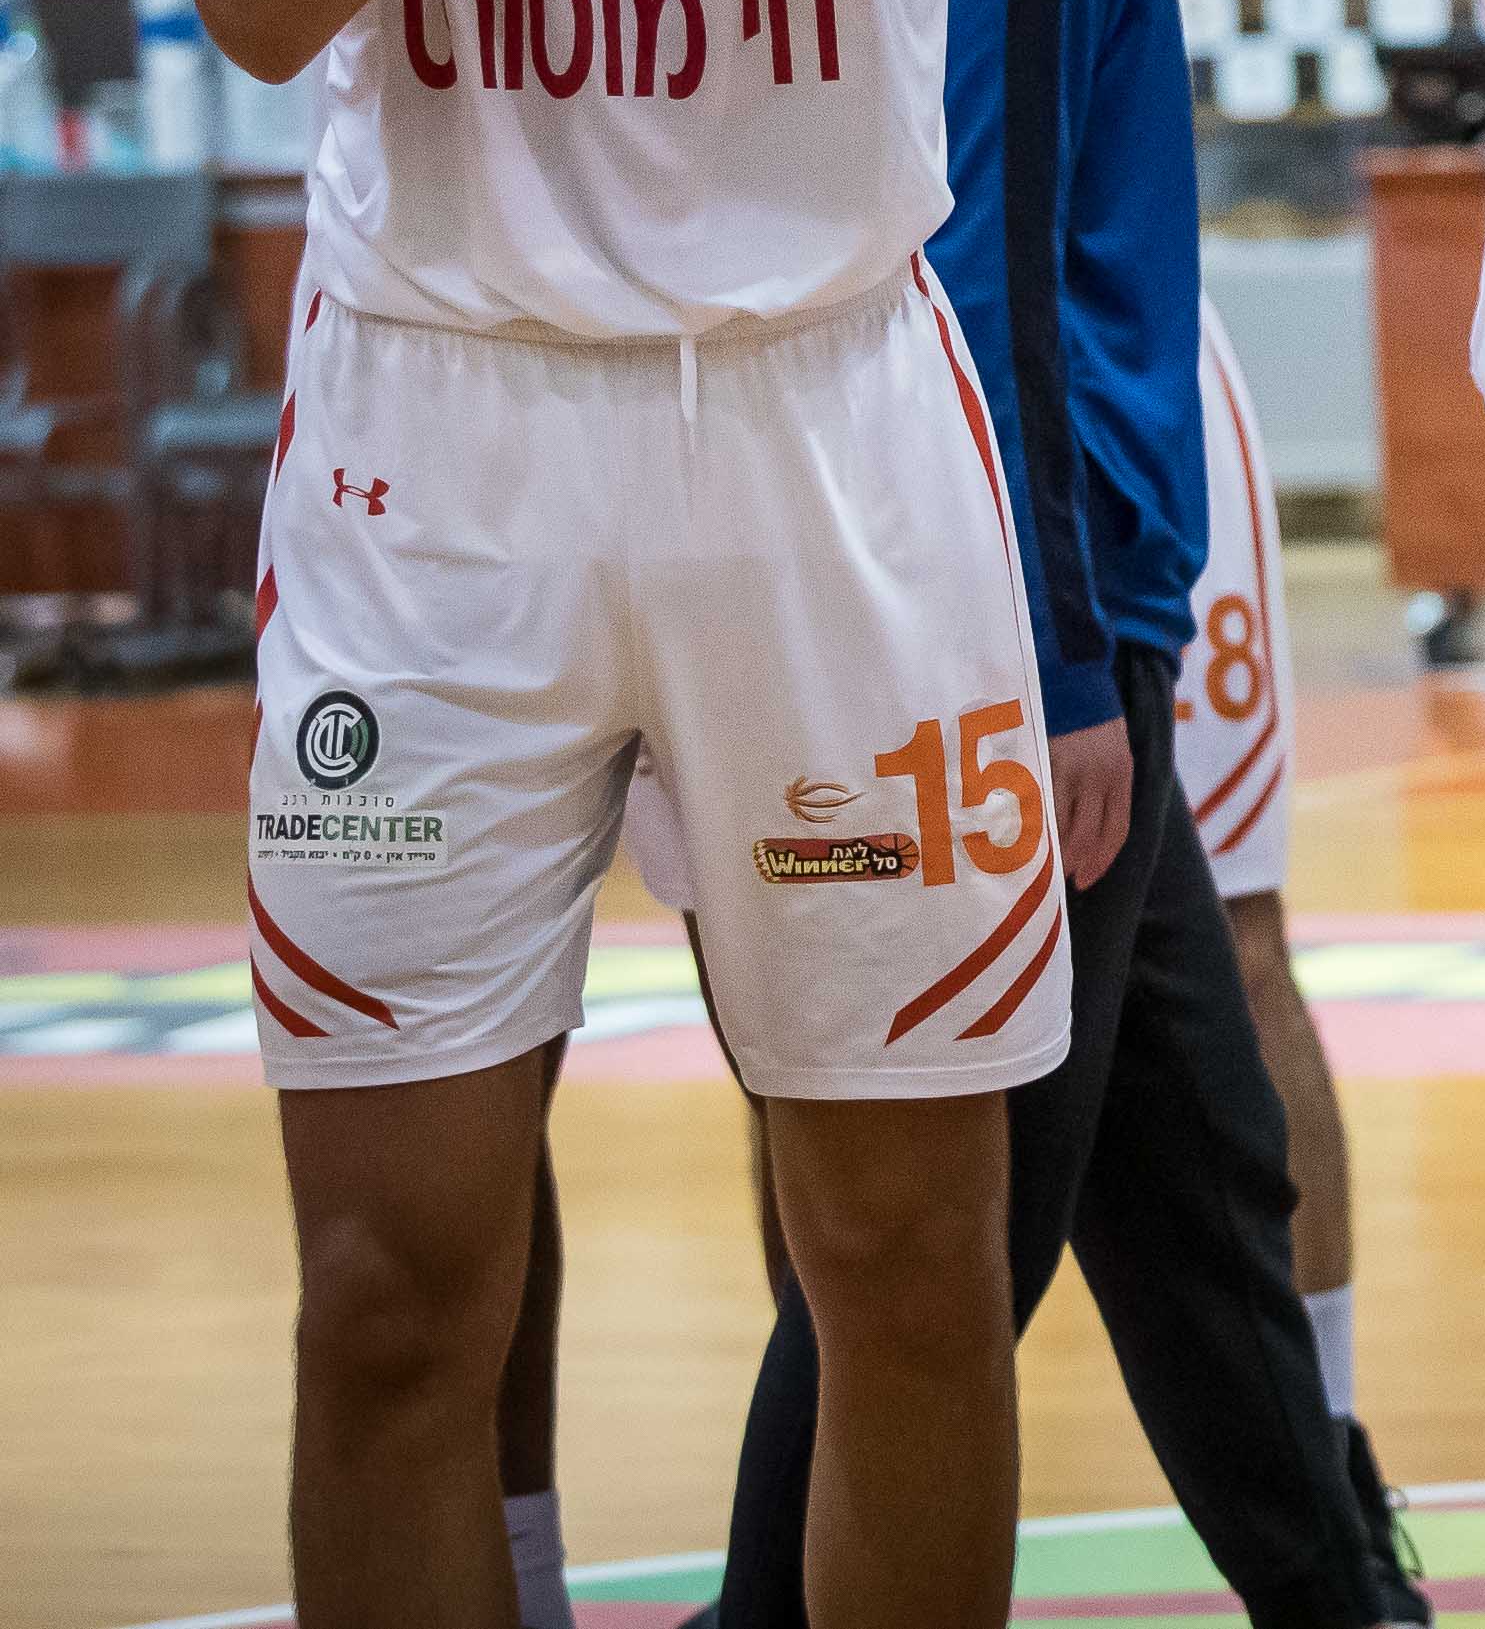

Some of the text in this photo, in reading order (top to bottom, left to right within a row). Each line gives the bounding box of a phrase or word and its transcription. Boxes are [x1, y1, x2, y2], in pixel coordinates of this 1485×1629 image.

[875, 698, 1043, 888] 15
[256, 814, 443, 843] TRADECENTER
[832, 842, 869, 859] ליגת
[873, 852, 898, 871] סל
[768, 851, 870, 875] Winner
